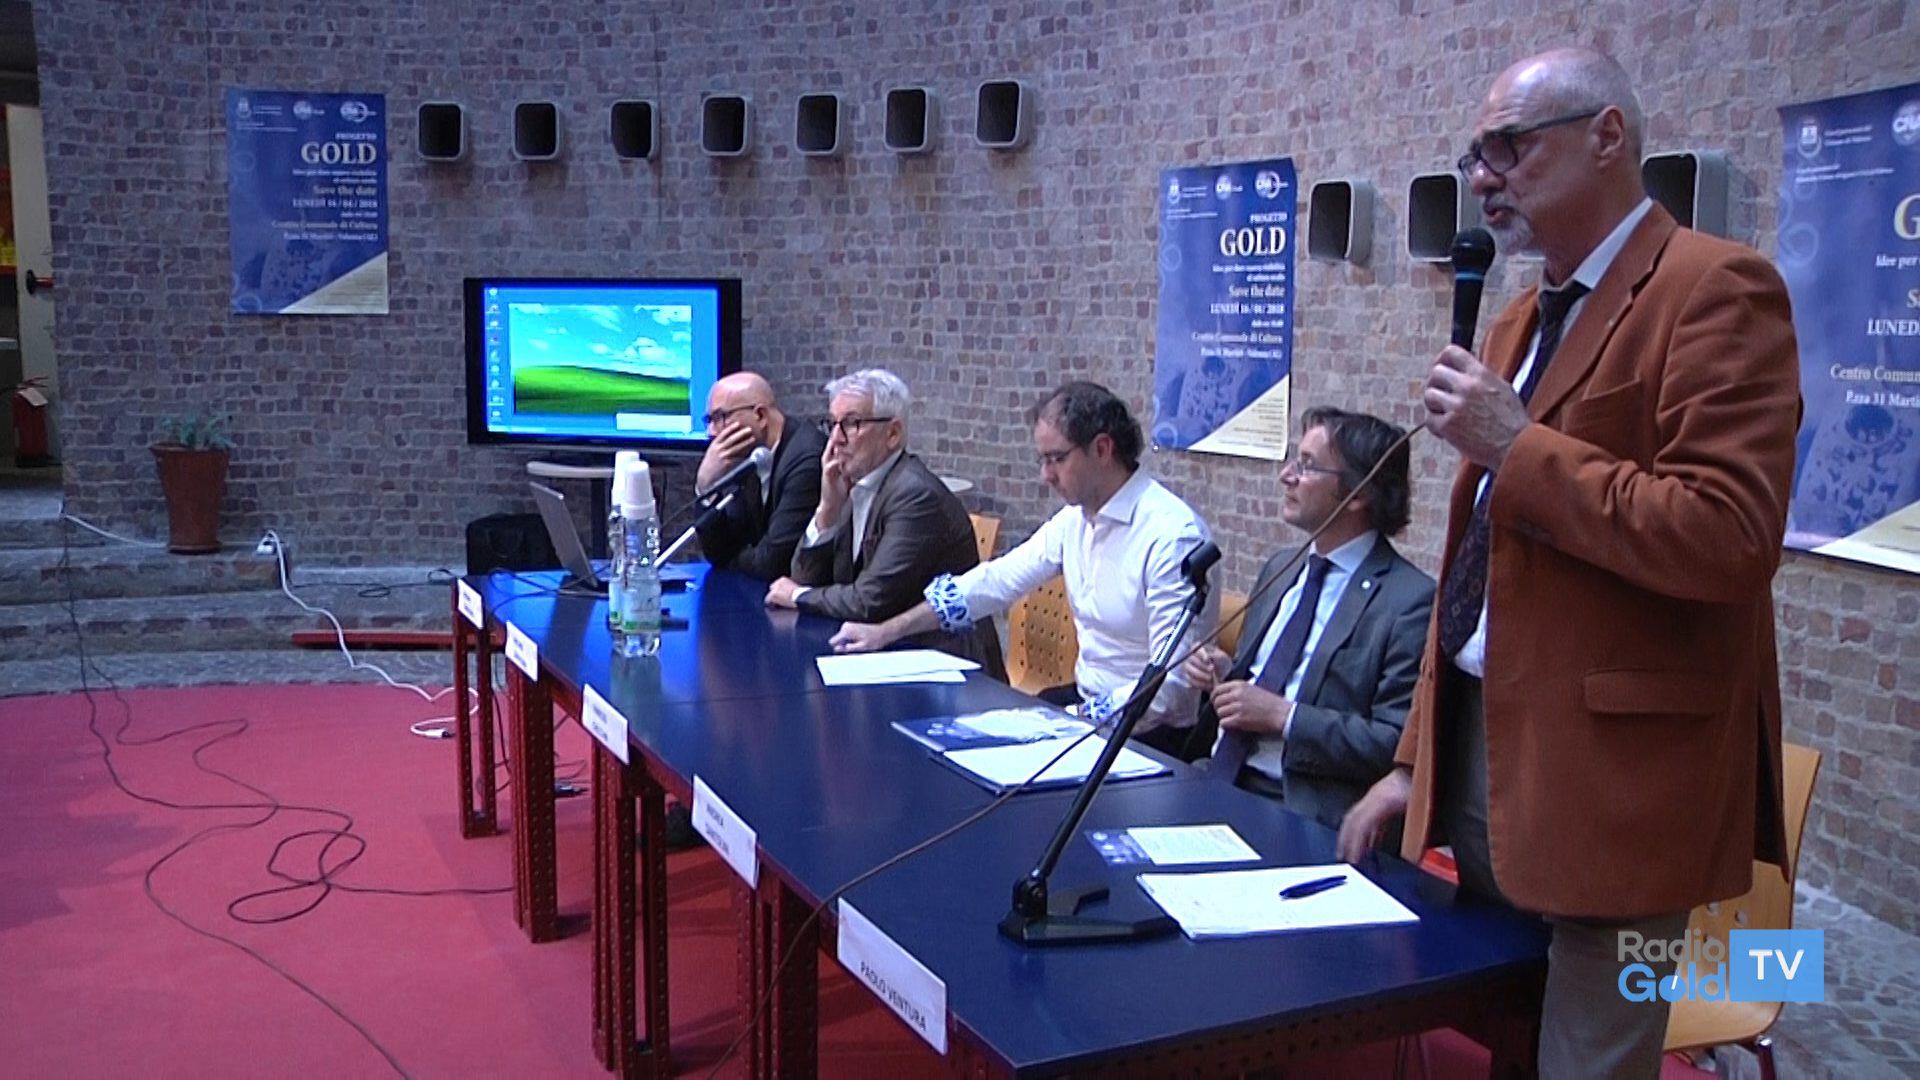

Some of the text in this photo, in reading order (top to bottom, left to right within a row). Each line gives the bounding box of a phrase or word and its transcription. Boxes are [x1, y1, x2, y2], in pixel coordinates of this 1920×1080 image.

[335, 132, 377, 140] PROGETTO
[301, 141, 377, 165] GOLD
[313, 185, 377, 196] Save the date
[1250, 212, 1287, 223] PROGETTO
[1220, 226, 1286, 256] GOLD
[1875, 254, 1918, 270] Idee per
[1228, 283, 1285, 297] Save the date
[1831, 362, 1871, 381] Centro
[1873, 391, 1885, 406] 31
[860, 960, 926, 1032] PAOLO VENTURA
